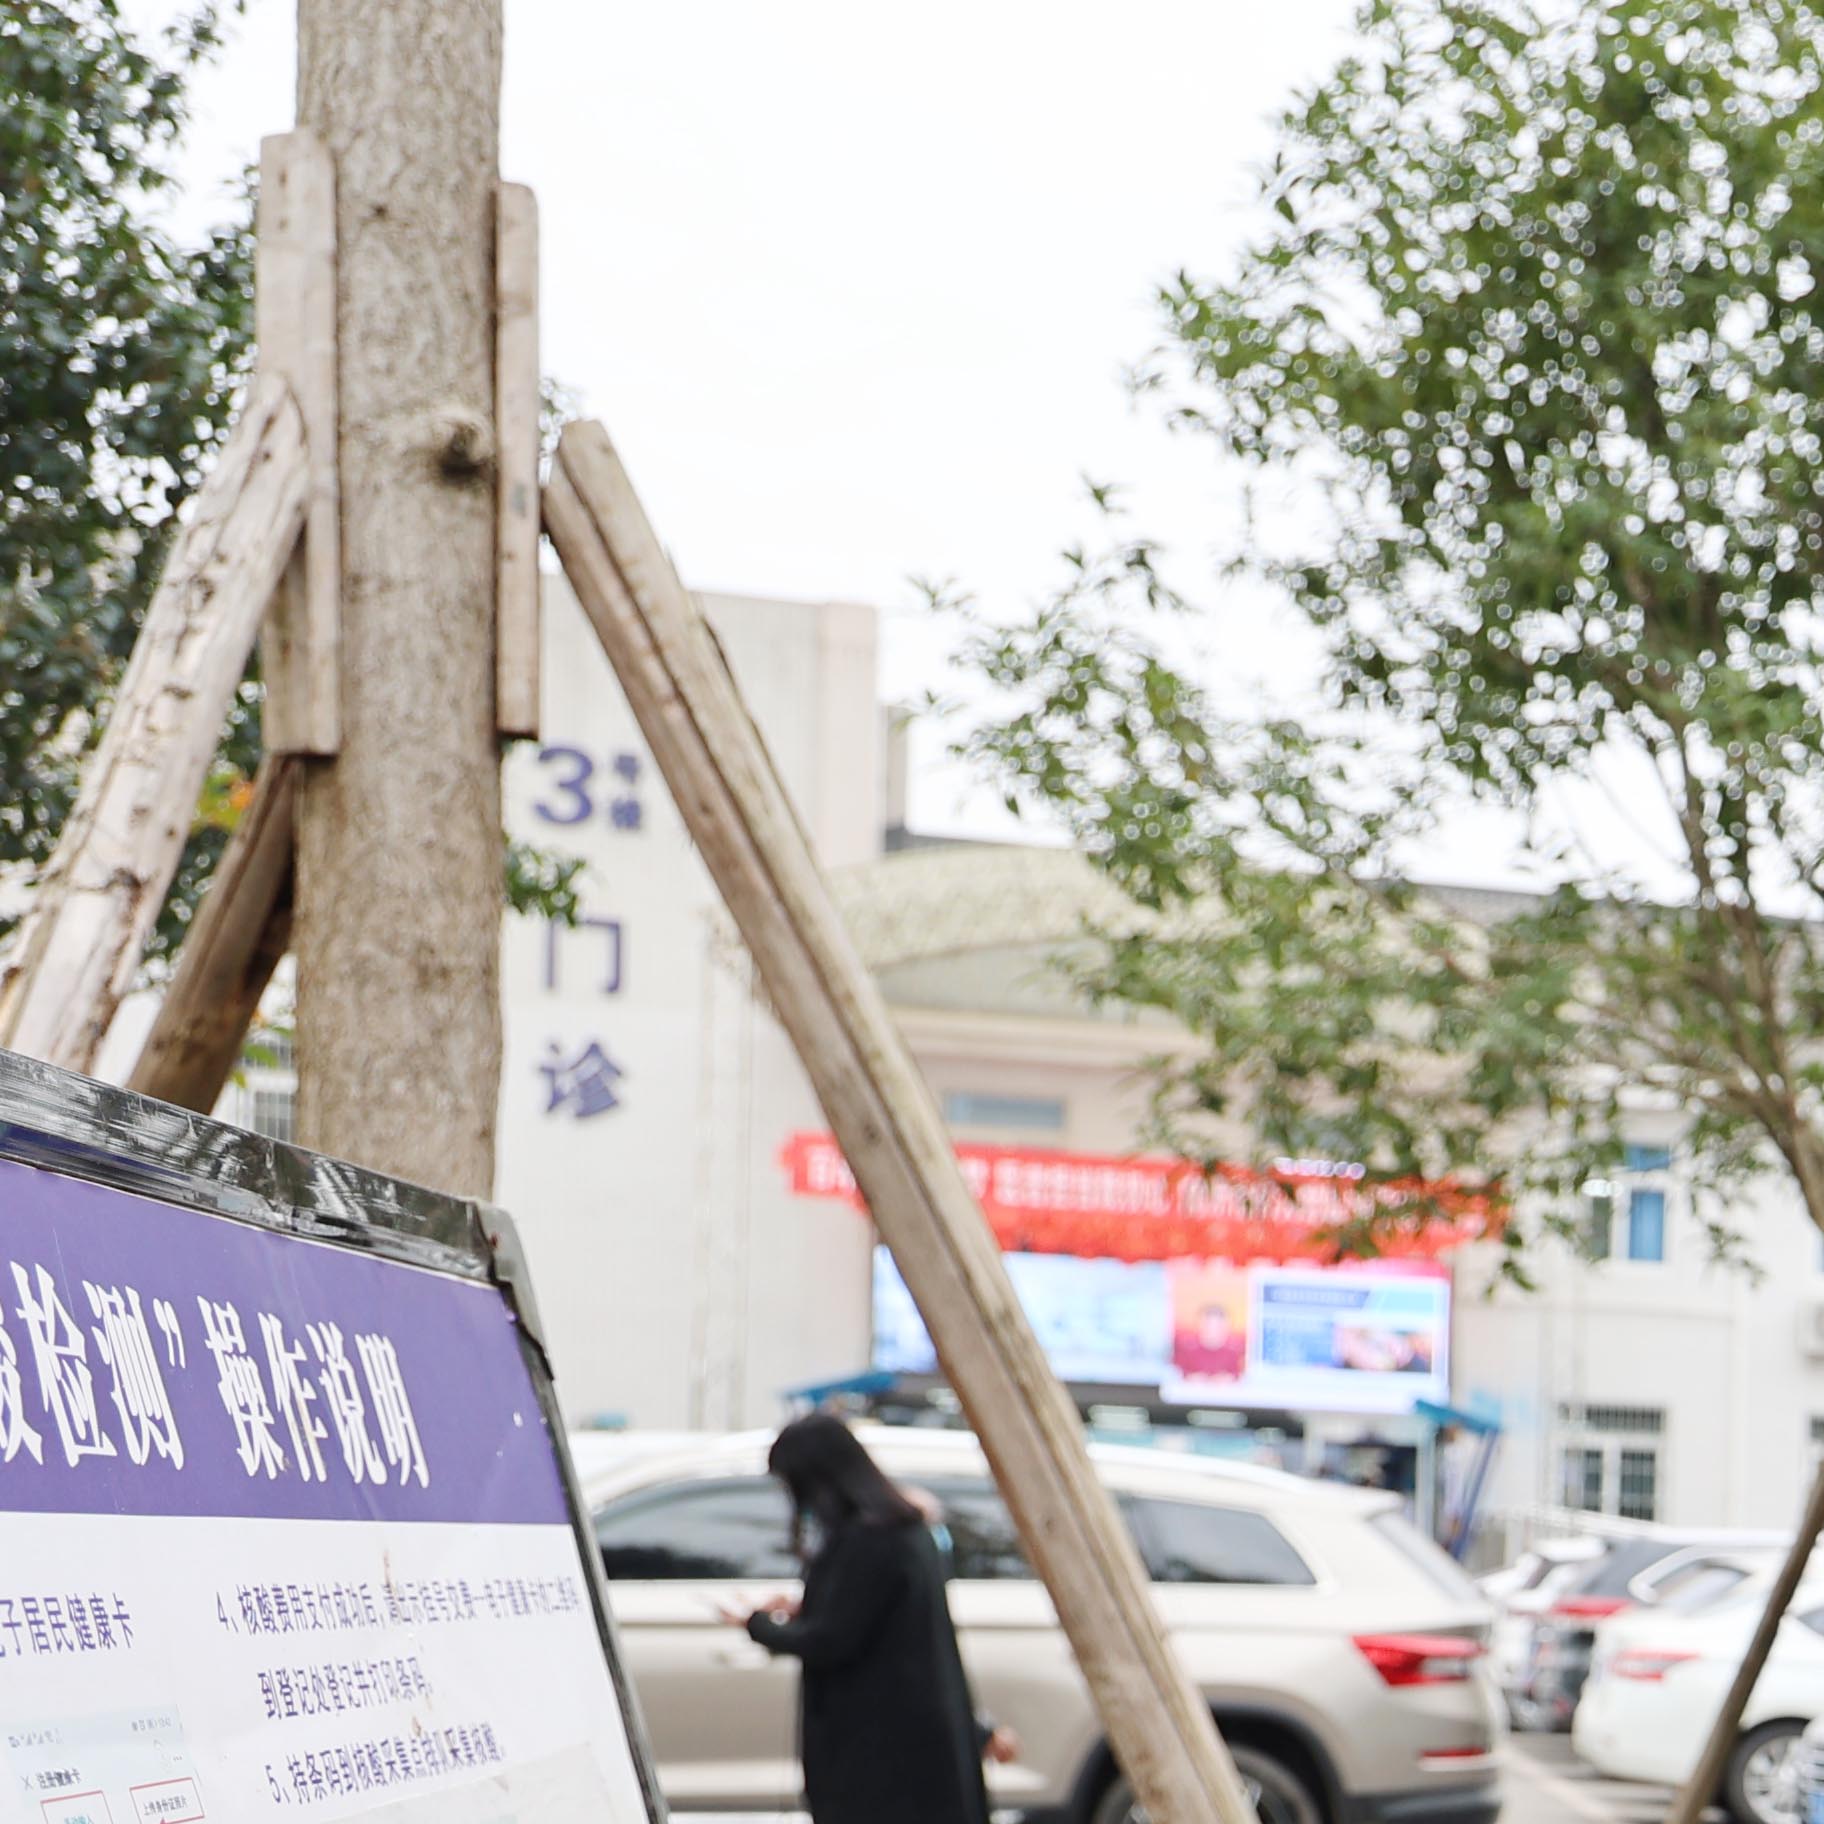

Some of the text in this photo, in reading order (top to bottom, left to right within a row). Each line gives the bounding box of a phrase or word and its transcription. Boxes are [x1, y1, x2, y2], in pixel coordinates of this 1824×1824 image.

[0, 1593, 133, 1657] 子居民健康卡
